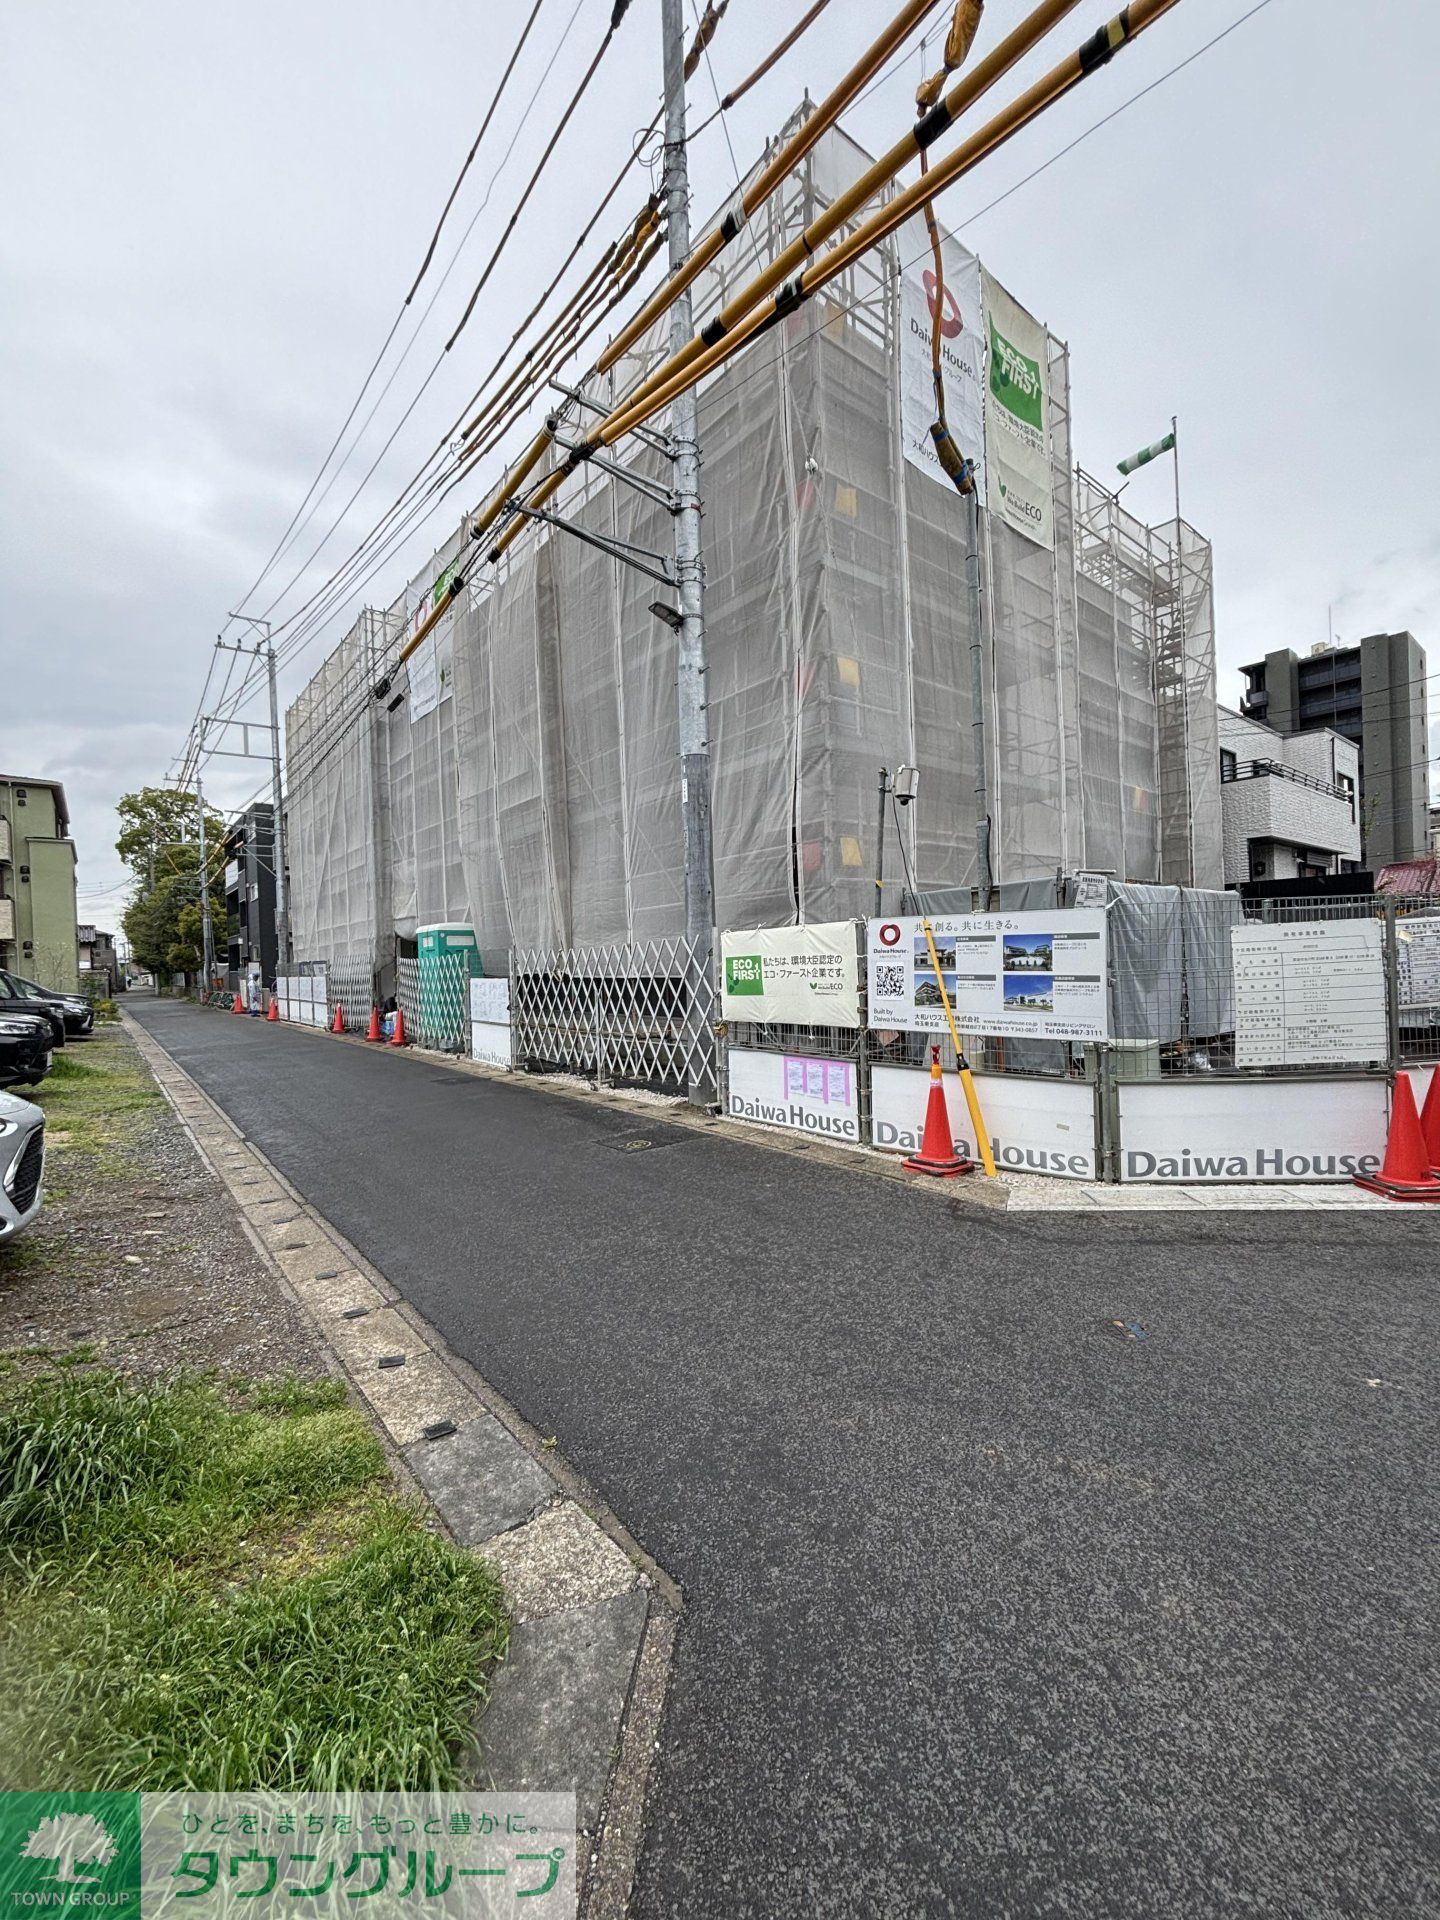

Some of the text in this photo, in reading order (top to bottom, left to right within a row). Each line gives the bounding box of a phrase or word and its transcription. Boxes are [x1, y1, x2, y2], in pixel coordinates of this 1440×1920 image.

[943, 344, 973, 376] House
[997, 337, 1028, 373] ECO
[1002, 356, 1040, 399] FIRST
[1025, 502, 1042, 522] ECO
[914, 919, 1020, 933] 共創る。共に生きる。
[732, 959, 753, 970] ECO
[763, 954, 843, 967] 私たちは、環境大臣認定の
[733, 966, 761, 980] FIRST
[763, 967, 845, 979] エコ・ファースト企業です。
[830, 982, 843, 991] ECO
[914, 1013, 980, 1023] 大和ハウス工株式会社
[1056, 1028, 1103, 1036] 048-987-3111
[731, 1095, 856, 1136] Daiwa House
[876, 1121, 971, 1157] Daia
[1127, 1148, 1381, 1178] Daiwa House
